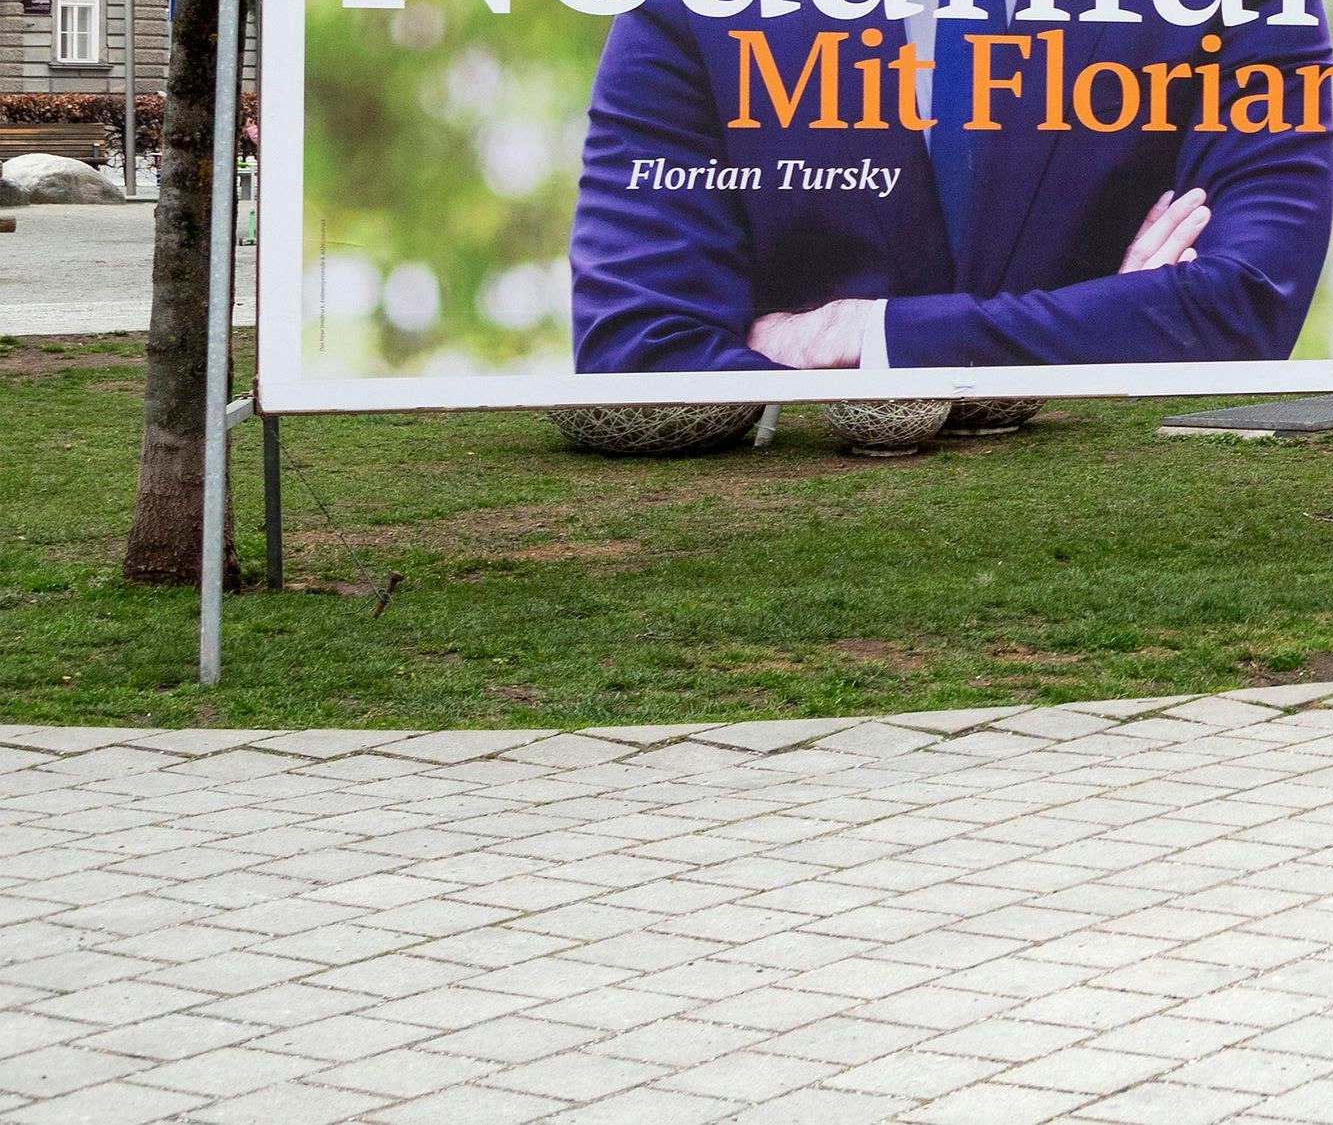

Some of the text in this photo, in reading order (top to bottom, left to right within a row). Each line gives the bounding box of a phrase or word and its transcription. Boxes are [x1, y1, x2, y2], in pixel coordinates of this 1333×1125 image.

[727, 28, 938, 131] Mit
[627, 159, 901, 198] Florian Tursky
